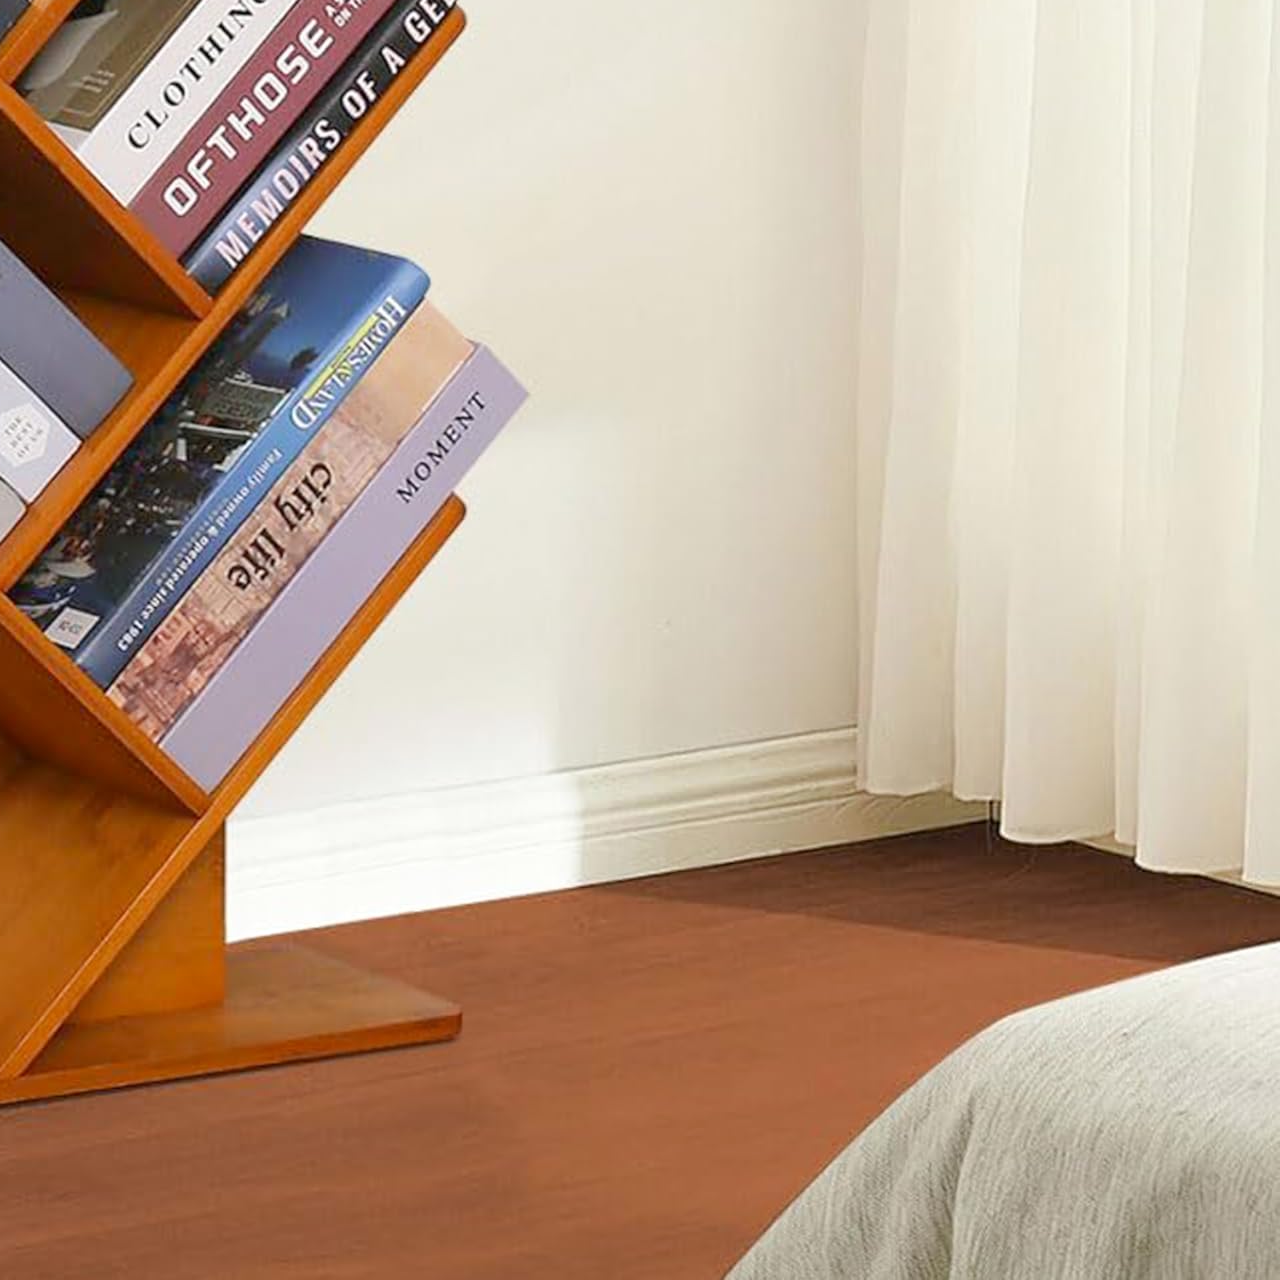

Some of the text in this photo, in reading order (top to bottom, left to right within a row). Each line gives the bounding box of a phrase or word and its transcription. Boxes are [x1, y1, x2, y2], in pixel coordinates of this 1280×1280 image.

[323, 2, 337, 16] A
[333, 8, 352, 27] ON
[162, 17, 334, 217] OFTHOSE
[215, 119, 340, 269] MEMOIRS
[341, 72, 377, 120] OF
[384, 46, 407, 75] A
[243, 447, 281, 487] Family
[397, 391, 488, 505] MOMENT
[213, 486, 250, 526] owned
[227, 462, 332, 593] city life
[161, 535, 212, 589] operated
[139, 588, 169, 620] since
